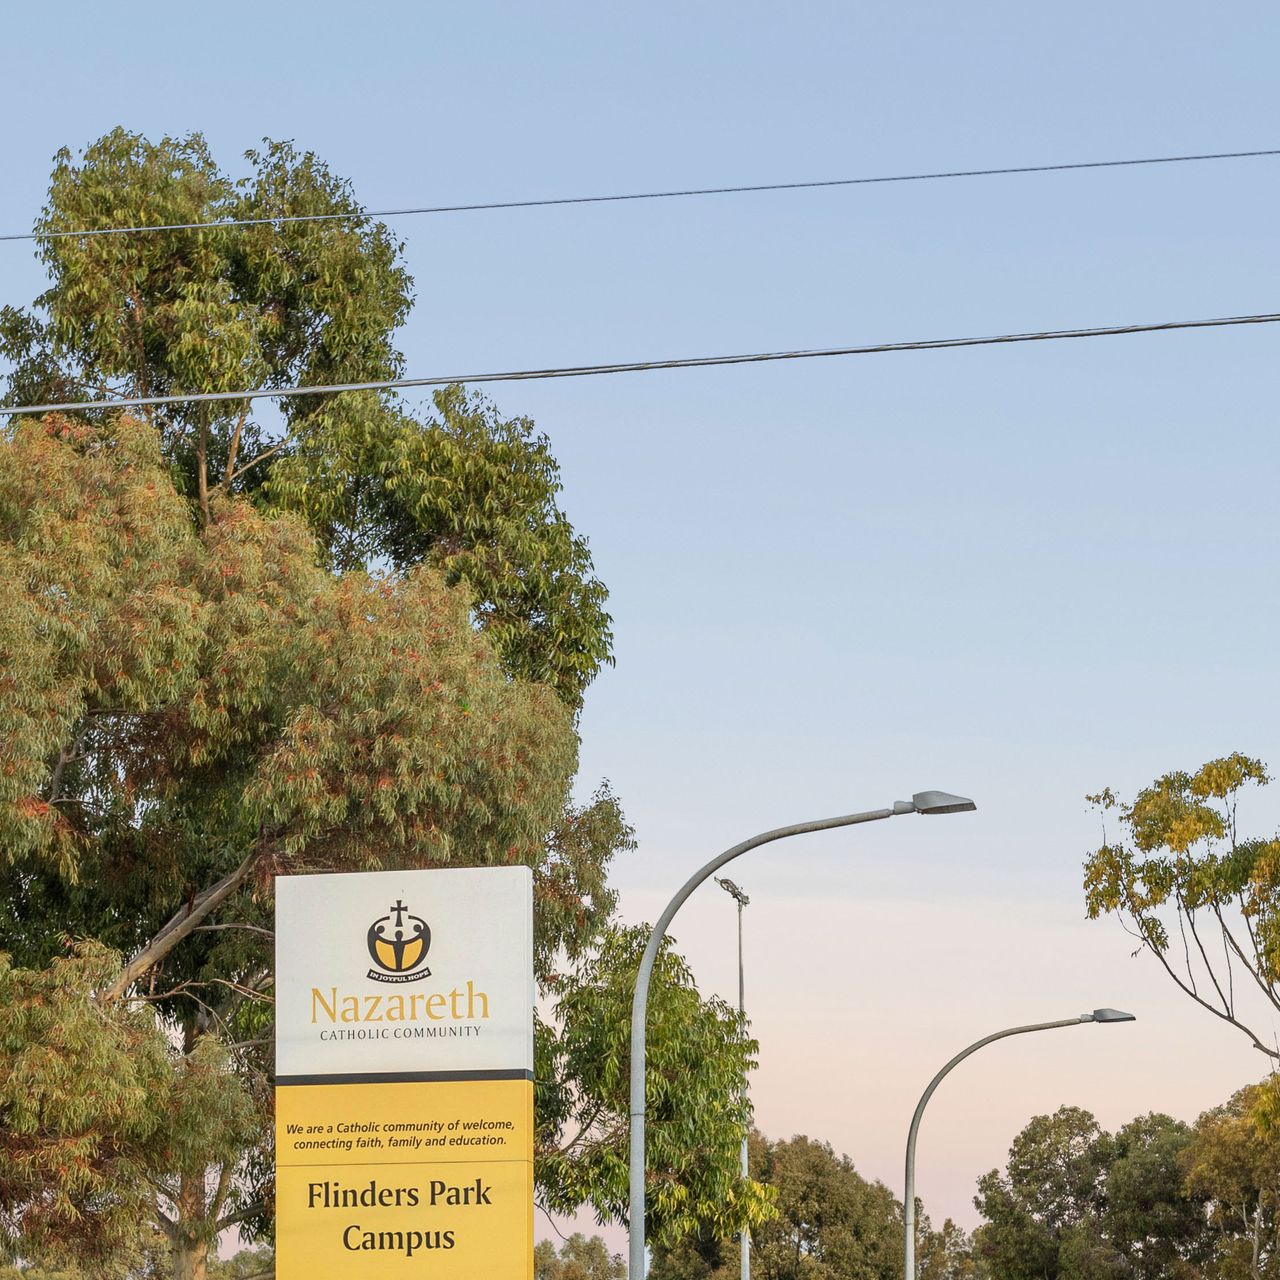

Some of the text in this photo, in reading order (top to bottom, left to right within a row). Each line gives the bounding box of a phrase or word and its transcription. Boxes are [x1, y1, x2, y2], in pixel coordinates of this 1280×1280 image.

[378, 974, 407, 982] JOYFUL
[407, 970, 429, 981] HOPE
[312, 980, 489, 1023] Nazareth
[320, 1026, 480, 1040] CATHOLIC COMMUNITY
[287, 1124, 303, 1134] We
[307, 1126, 324, 1134] are
[337, 1122, 380, 1133] Catholic
[383, 1122, 444, 1133] community
[448, 1120, 460, 1130] of
[463, 1119, 514, 1130] welcome,
[294, 1135, 506, 1151] connecting faith, family and education.
[309, 1178, 492, 1208] Flinders Park
[343, 1225, 454, 1257] Campus
